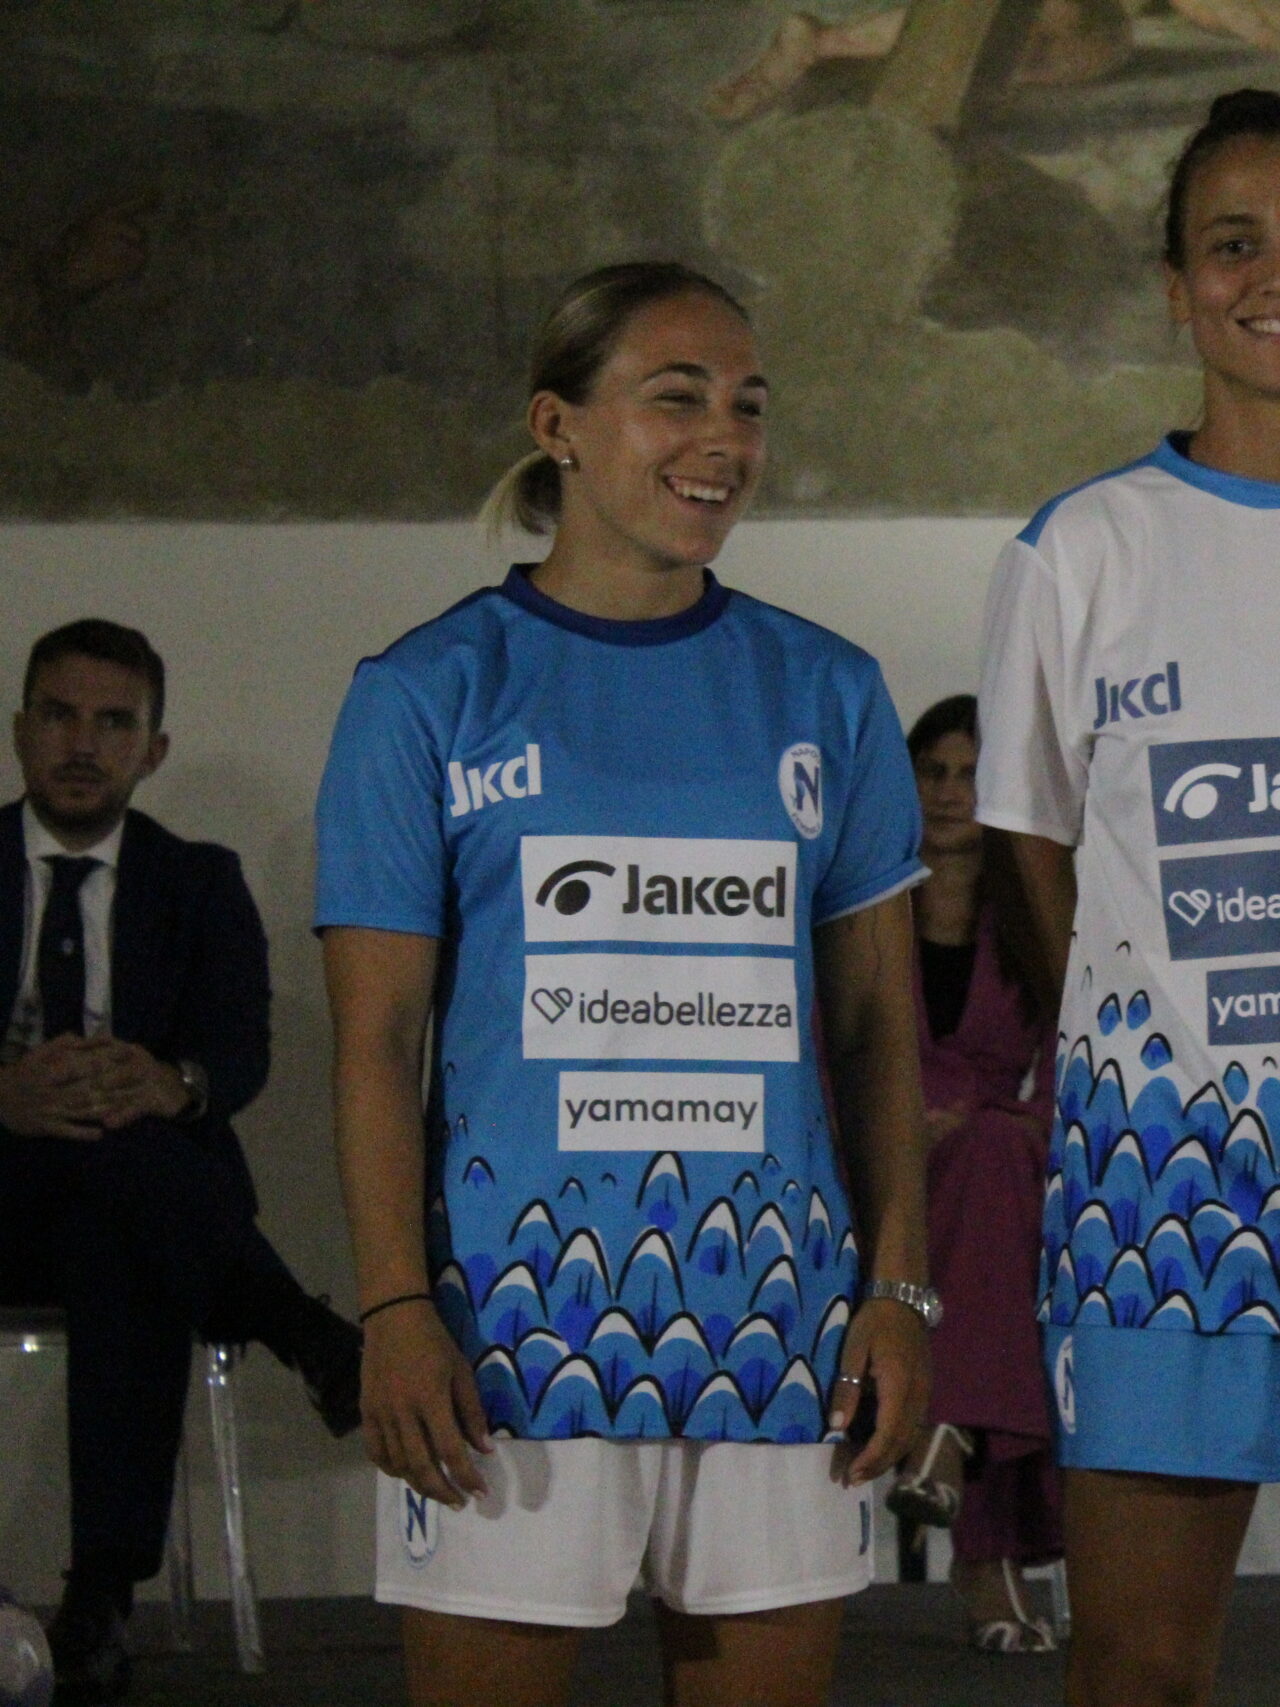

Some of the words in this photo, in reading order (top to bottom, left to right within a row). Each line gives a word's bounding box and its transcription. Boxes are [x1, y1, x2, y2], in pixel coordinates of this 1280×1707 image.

[1093, 661, 1182, 730] Jkd
[449, 743, 541, 818] Jkd
[622, 864, 786, 918] Jaked
[579, 990, 792, 1029] ideabellezza
[565, 1094, 758, 1130] yamamay
